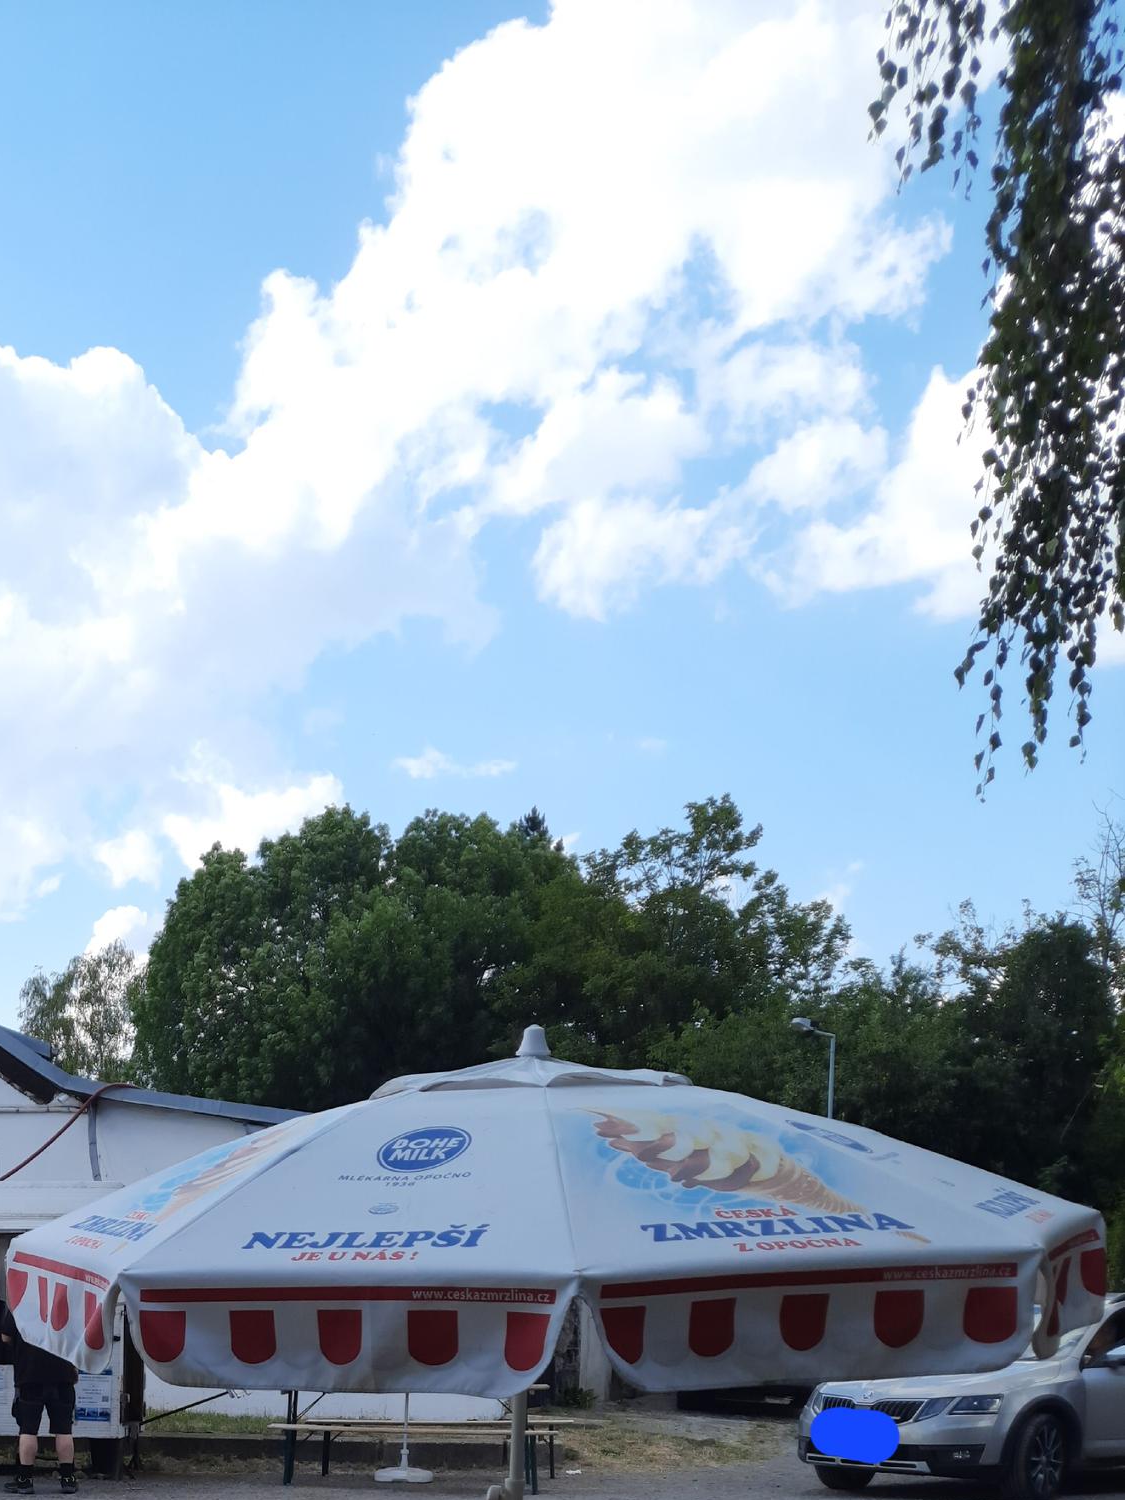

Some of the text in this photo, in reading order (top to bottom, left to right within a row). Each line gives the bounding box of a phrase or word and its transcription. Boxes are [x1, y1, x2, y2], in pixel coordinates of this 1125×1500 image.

[392, 1136, 464, 1149] BOHE
[388, 1147, 452, 1161] MILK
[715, 1205, 798, 1219] ČESKÁ
[641, 1213, 915, 1242] ZMRZLINA
[242, 1224, 490, 1249] NEJLEPŠÍ
[733, 1237, 862, 1252] Z OPOČNA
[291, 1252, 323, 1261] JE
[328, 1252, 346, 1261] U
[352, 1249, 405, 1261] NÁS
[412, 1288, 551, 1303] www.ceskazmrzlina.cz
